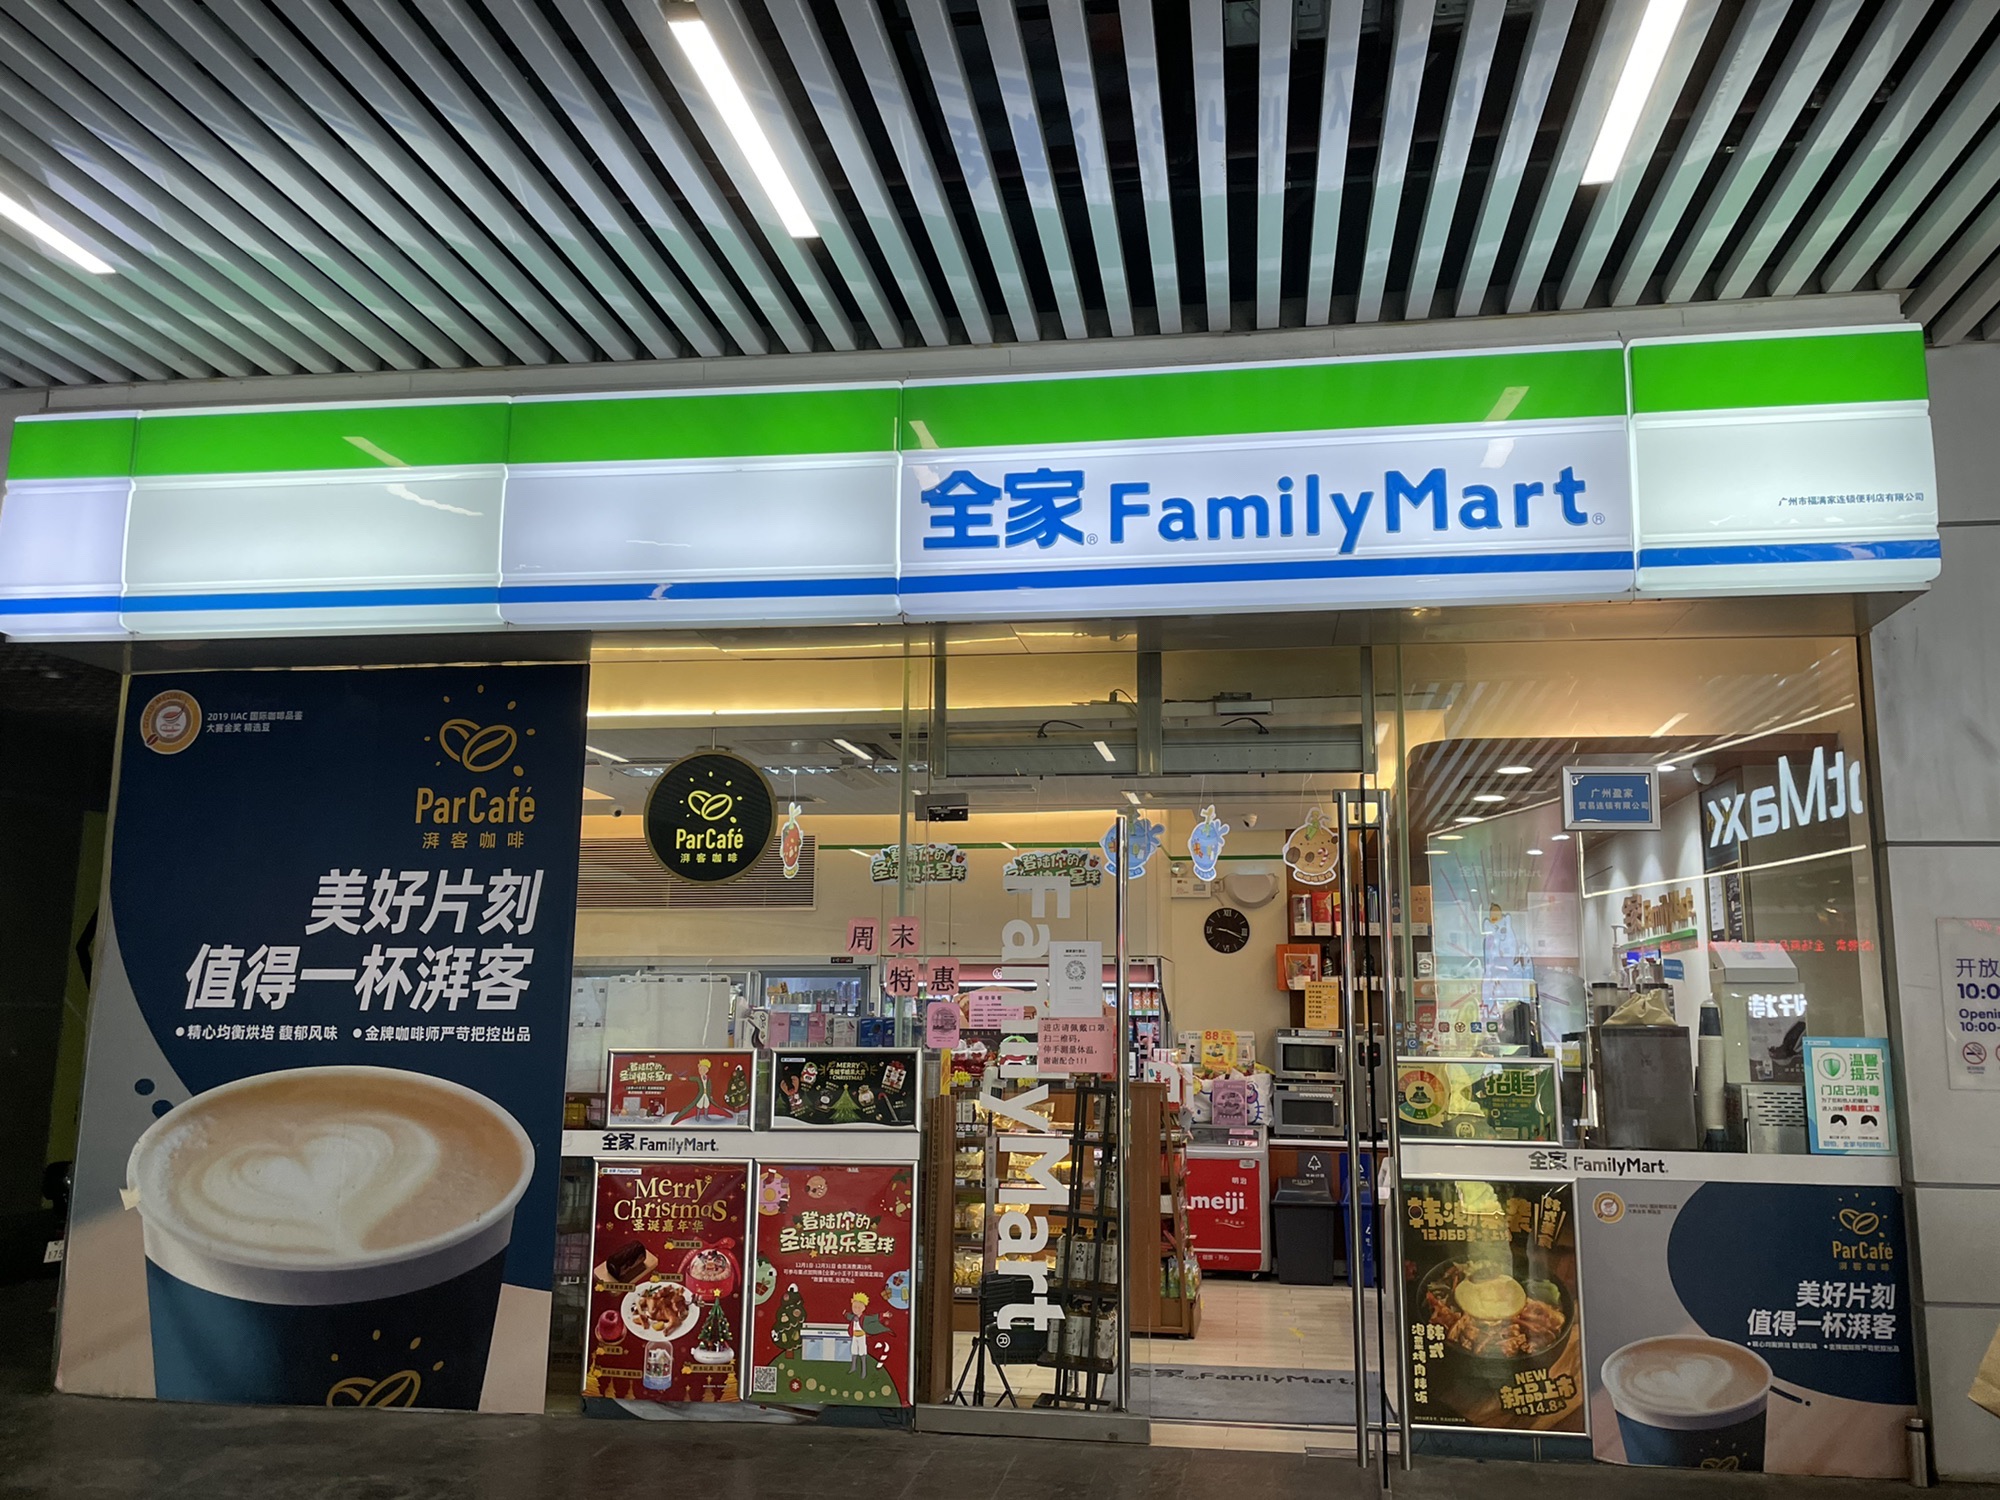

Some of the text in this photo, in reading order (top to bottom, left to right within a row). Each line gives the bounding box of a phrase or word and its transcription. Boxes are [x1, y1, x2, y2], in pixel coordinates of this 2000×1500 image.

[921, 465, 1589, 555] 全家 FamilyMart
[1778, 492, 1925, 506] 广州市福满家连锁便利店有限公司
[207, 713, 229, 721] 2019
[415, 786, 536, 824] ParCafé
[422, 831, 525, 849] 湃客咖啡
[675, 828, 744, 850] ParCafé
[305, 868, 544, 935] 美好片刻
[850, 923, 915, 951] 周末
[185, 942, 534, 1012] 值得一杯湃客
[889, 965, 955, 993] 特惠
[1850, 1067, 1880, 1081] 提示
[1821, 1084, 1879, 1096] 门店已消毒
[602, 1133, 716, 1155] 全家 FamilyMart
[1528, 1151, 1666, 1175] 全家 FamilyMart
[634, 1177, 712, 1203] Merry
[1190, 1191, 1245, 1215] meiji
[632, 1219, 704, 1232] 圣诞嘉年华
[801, 1211, 871, 1231] 登陆你的
[780, 1228, 895, 1255] 圣诞快乐星球
[1832, 1241, 1893, 1260] ParCafé
[1796, 1281, 1896, 1310] 美好片刻
[1747, 1309, 1896, 1340] 值得一杯湃客
[1426, 1324, 1445, 1359] 韩式
[1200, 1372, 1348, 1385] FamilyMart
[1515, 1369, 1547, 1384] NEW
[1500, 1377, 1576, 1408] 新品上市
